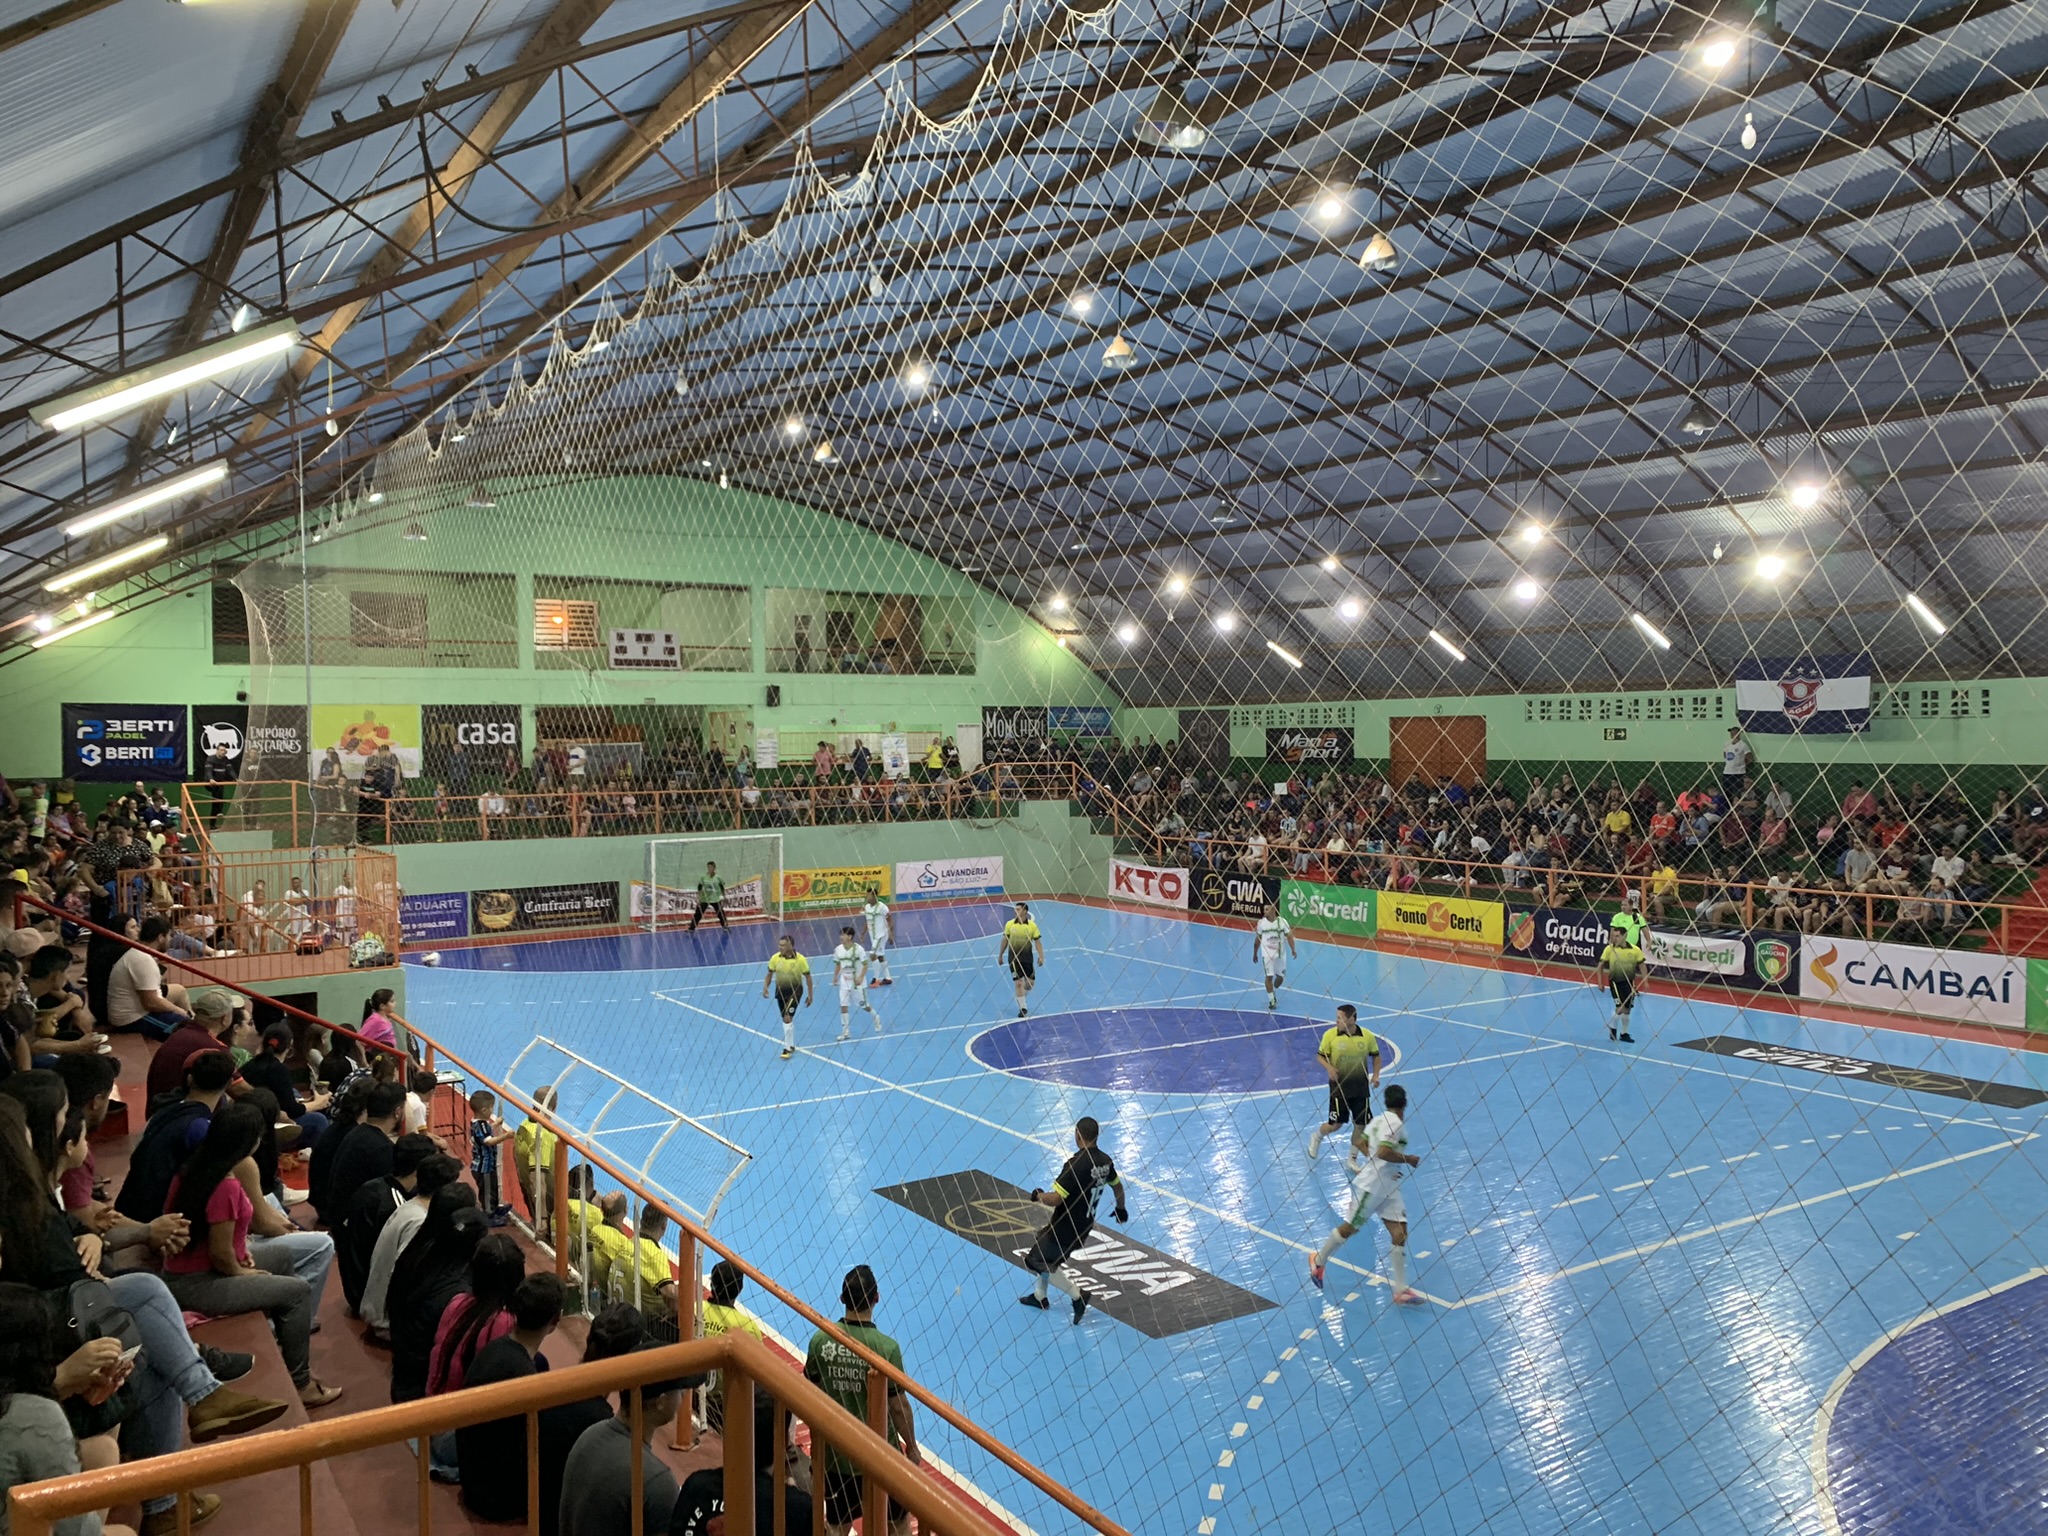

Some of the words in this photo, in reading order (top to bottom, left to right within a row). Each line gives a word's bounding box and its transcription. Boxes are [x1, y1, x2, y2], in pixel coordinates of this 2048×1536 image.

[1787, 700, 1817, 715] AGSL
[106, 720, 174, 732] BERTI
[250, 725, 297, 740] EMPÓRIO
[264, 740, 302, 754] CARNES
[1280, 733, 1337, 749] Mania
[105, 747, 154, 759] BERTI
[1282, 748, 1342, 762] Sport
[814, 870, 882, 883] FERRAGEM
[941, 867, 989, 878] LAVANDERIA
[811, 876, 880, 896] Dalcin
[1115, 865, 1182, 899] KTO
[1227, 880, 1263, 903] CWA
[414, 899, 462, 911] DUARTE
[524, 900, 581, 913] Confraria
[584, 896, 612, 908] Beer
[1231, 903, 1261, 914] ENERGIA
[1309, 895, 1369, 922] Sicredi
[1395, 907, 1427, 925] Ponto
[1450, 913, 1482, 933] Certo
[1545, 918, 1610, 945] Gauch
[1545, 940, 1560, 953] de
[1560, 943, 1595, 958] futsal
[1672, 943, 1735, 965] Sicredi
[1845, 961, 2014, 1003] CAMBAÍ
[1733, 1048, 1869, 1075] CWA
